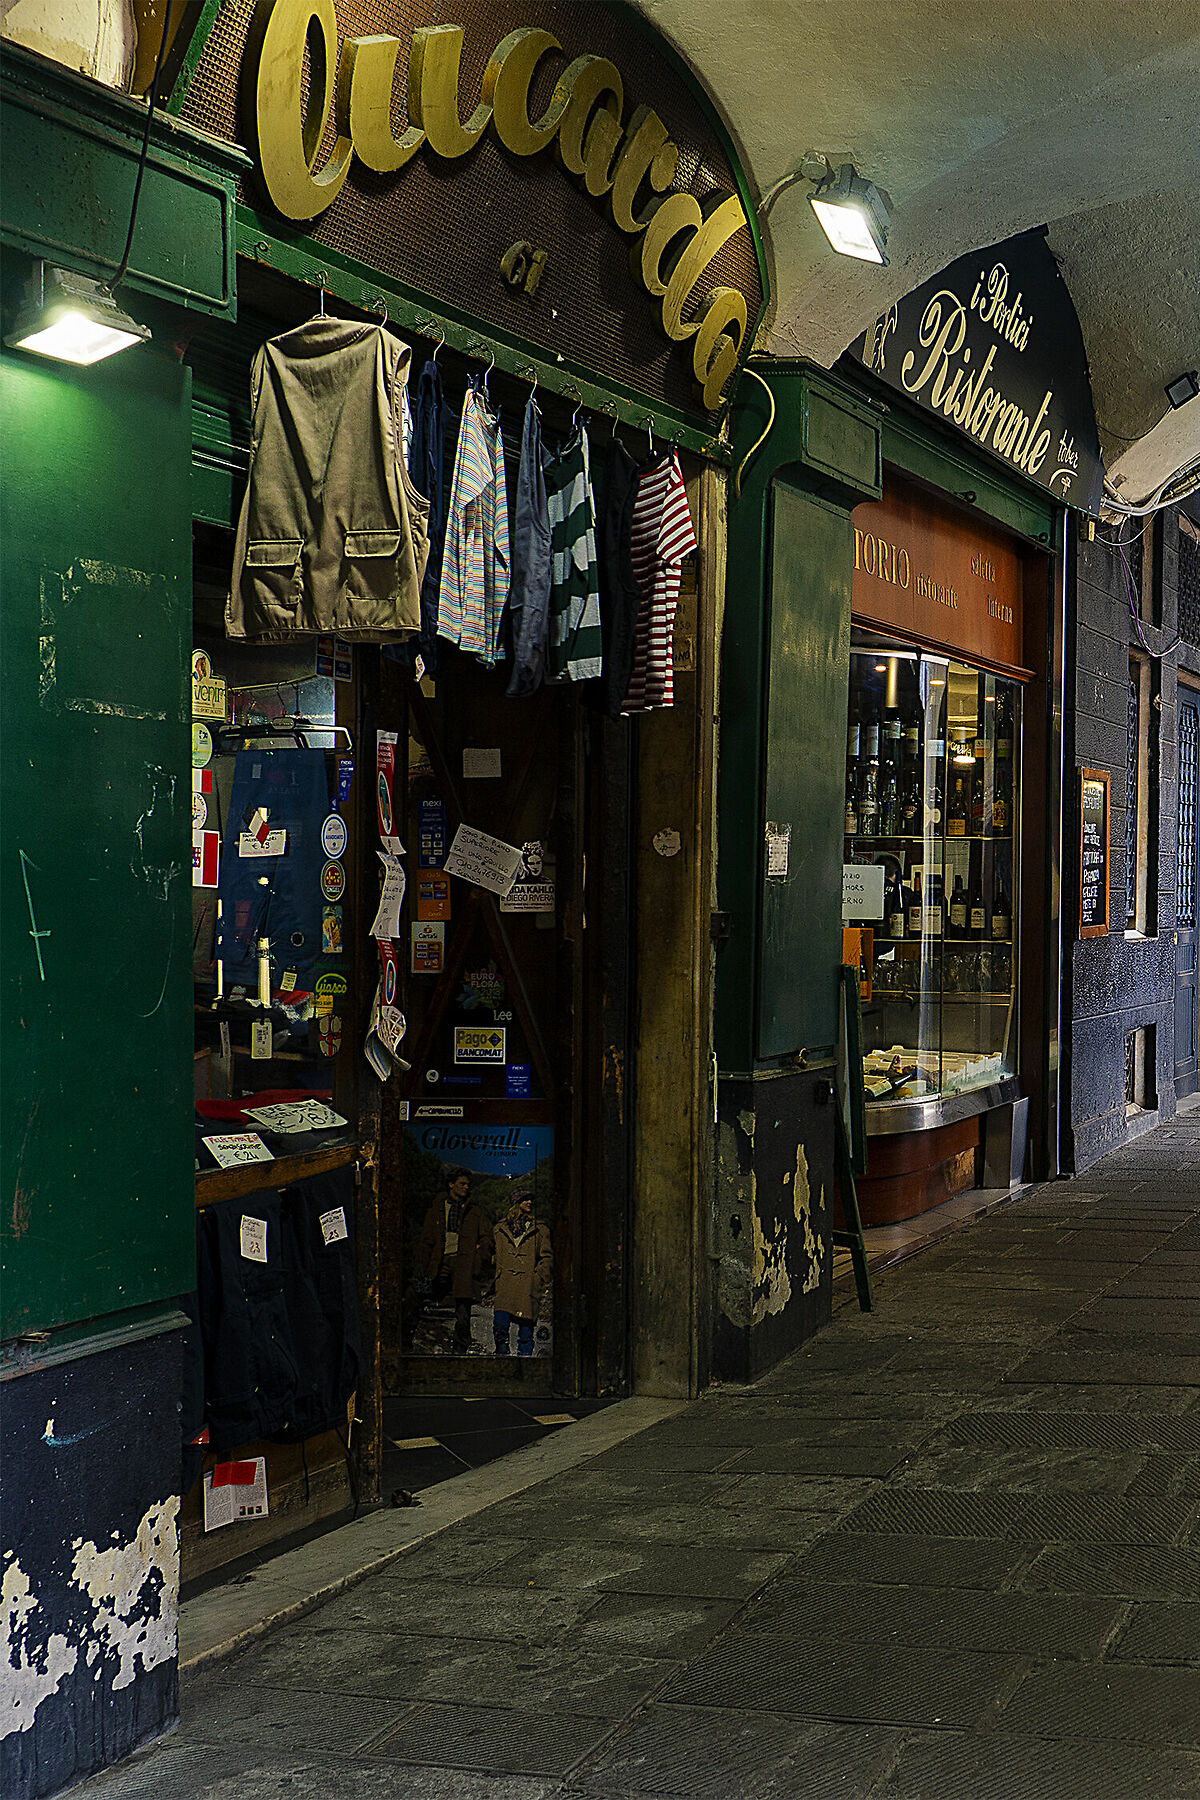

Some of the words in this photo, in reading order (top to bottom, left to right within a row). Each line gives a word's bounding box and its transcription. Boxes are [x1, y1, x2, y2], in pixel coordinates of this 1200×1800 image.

[979, 262, 1034, 352] Portici
[901, 290, 1053, 475] Ristorante
[970, 552, 996, 584] saletta
[916, 573, 959, 610] ristorante
[986, 594, 1013, 625] interna
[527, 886, 555, 894] KAHLO
[315, 979, 347, 998] Giasco
[471, 973, 496, 981] EURO
[493, 1009, 512, 1021] Lee
[457, 1031, 487, 1048] Pago
[421, 1126, 521, 1151] Gloverall
